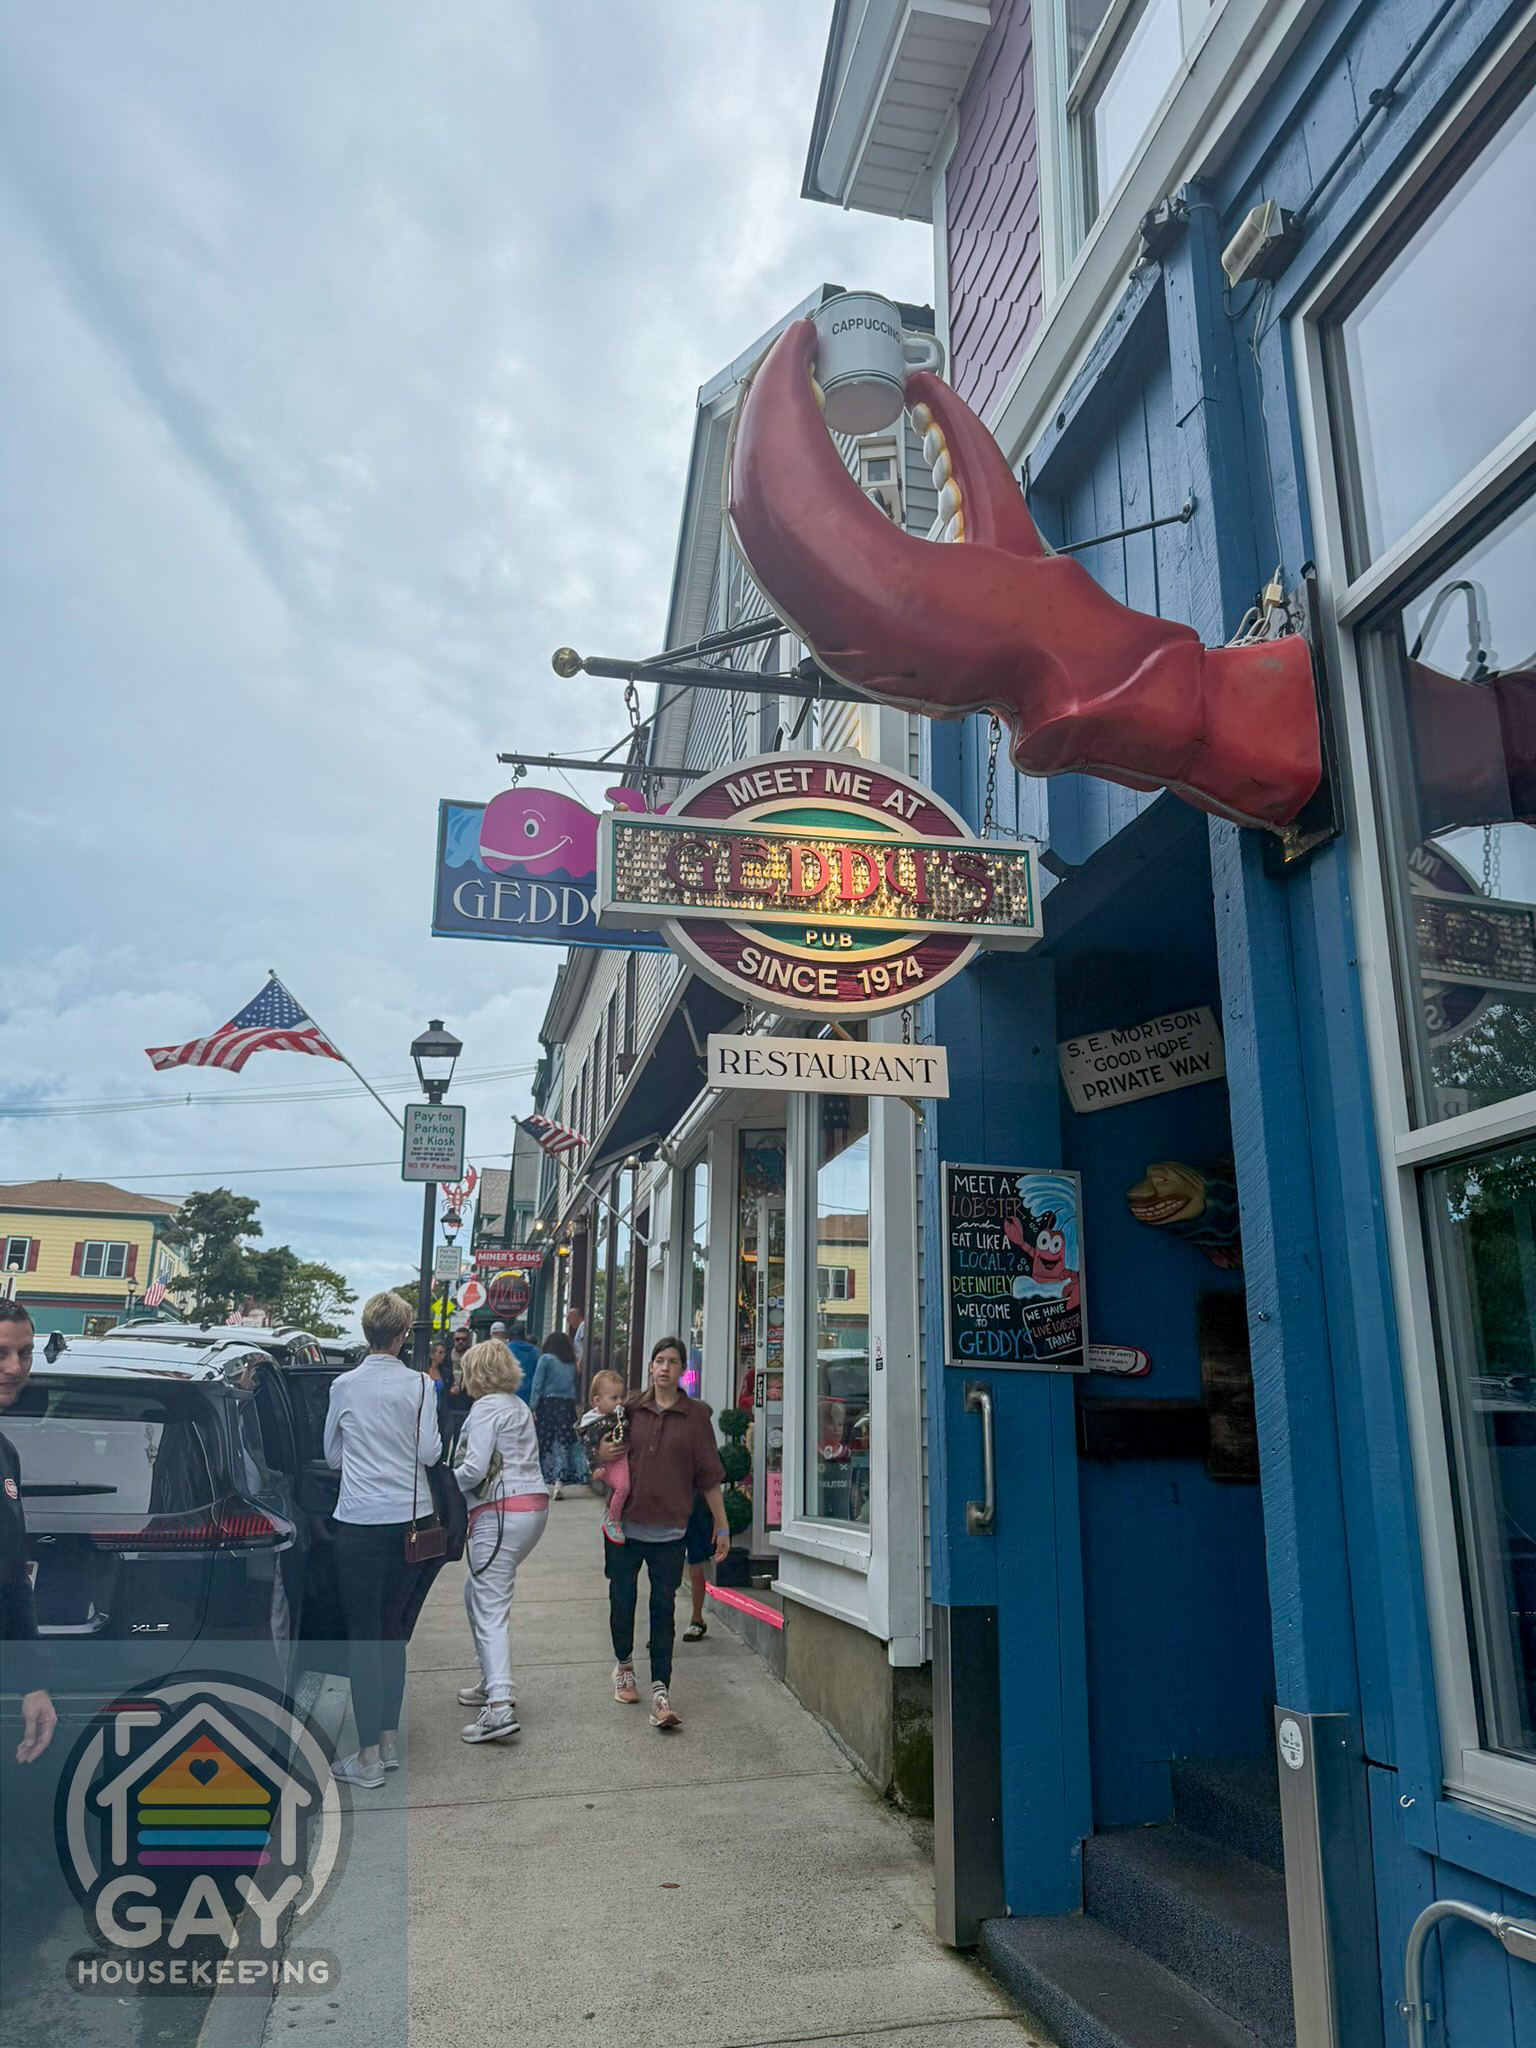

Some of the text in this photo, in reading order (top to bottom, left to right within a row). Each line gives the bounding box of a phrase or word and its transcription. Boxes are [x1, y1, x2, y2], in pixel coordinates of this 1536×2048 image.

[832, 317, 900, 344] CAPPUCCINO
[725, 768, 926, 820] MEET ME AT
[806, 929, 853, 948] PUB
[737, 947, 924, 996] SINCE 1974
[1067, 1011, 1202, 1058] S. E. MORISON
[1085, 1032, 1193, 1072] "GOOD HOPE"
[718, 1048, 938, 1084] RESTAURANT
[1082, 1052, 1211, 1101] PRIVATE WAY
[414, 1112, 453, 1122] Pay for
[414, 1124, 455, 1136] Parking
[413, 1136, 456, 1146] at Kiosk
[954, 1175, 1010, 1195] MEET A
[952, 1195, 1026, 1219] LOBSTER
[956, 1220, 1000, 1229] and
[952, 1232, 1011, 1250] EAT LIKE A
[478, 1252, 540, 1262] MINER'S GEMS
[952, 1274, 1016, 1294] DEFINITELY
[956, 1304, 1011, 1319] WELCOME
[1026, 1303, 1065, 1321] WE HAVE
[975, 1318, 988, 1327] TO
[1032, 1313, 1082, 1338] LIVE LOBSTER
[1046, 1329, 1076, 1350] TANK!
[131, 1624, 169, 1632] XLE
